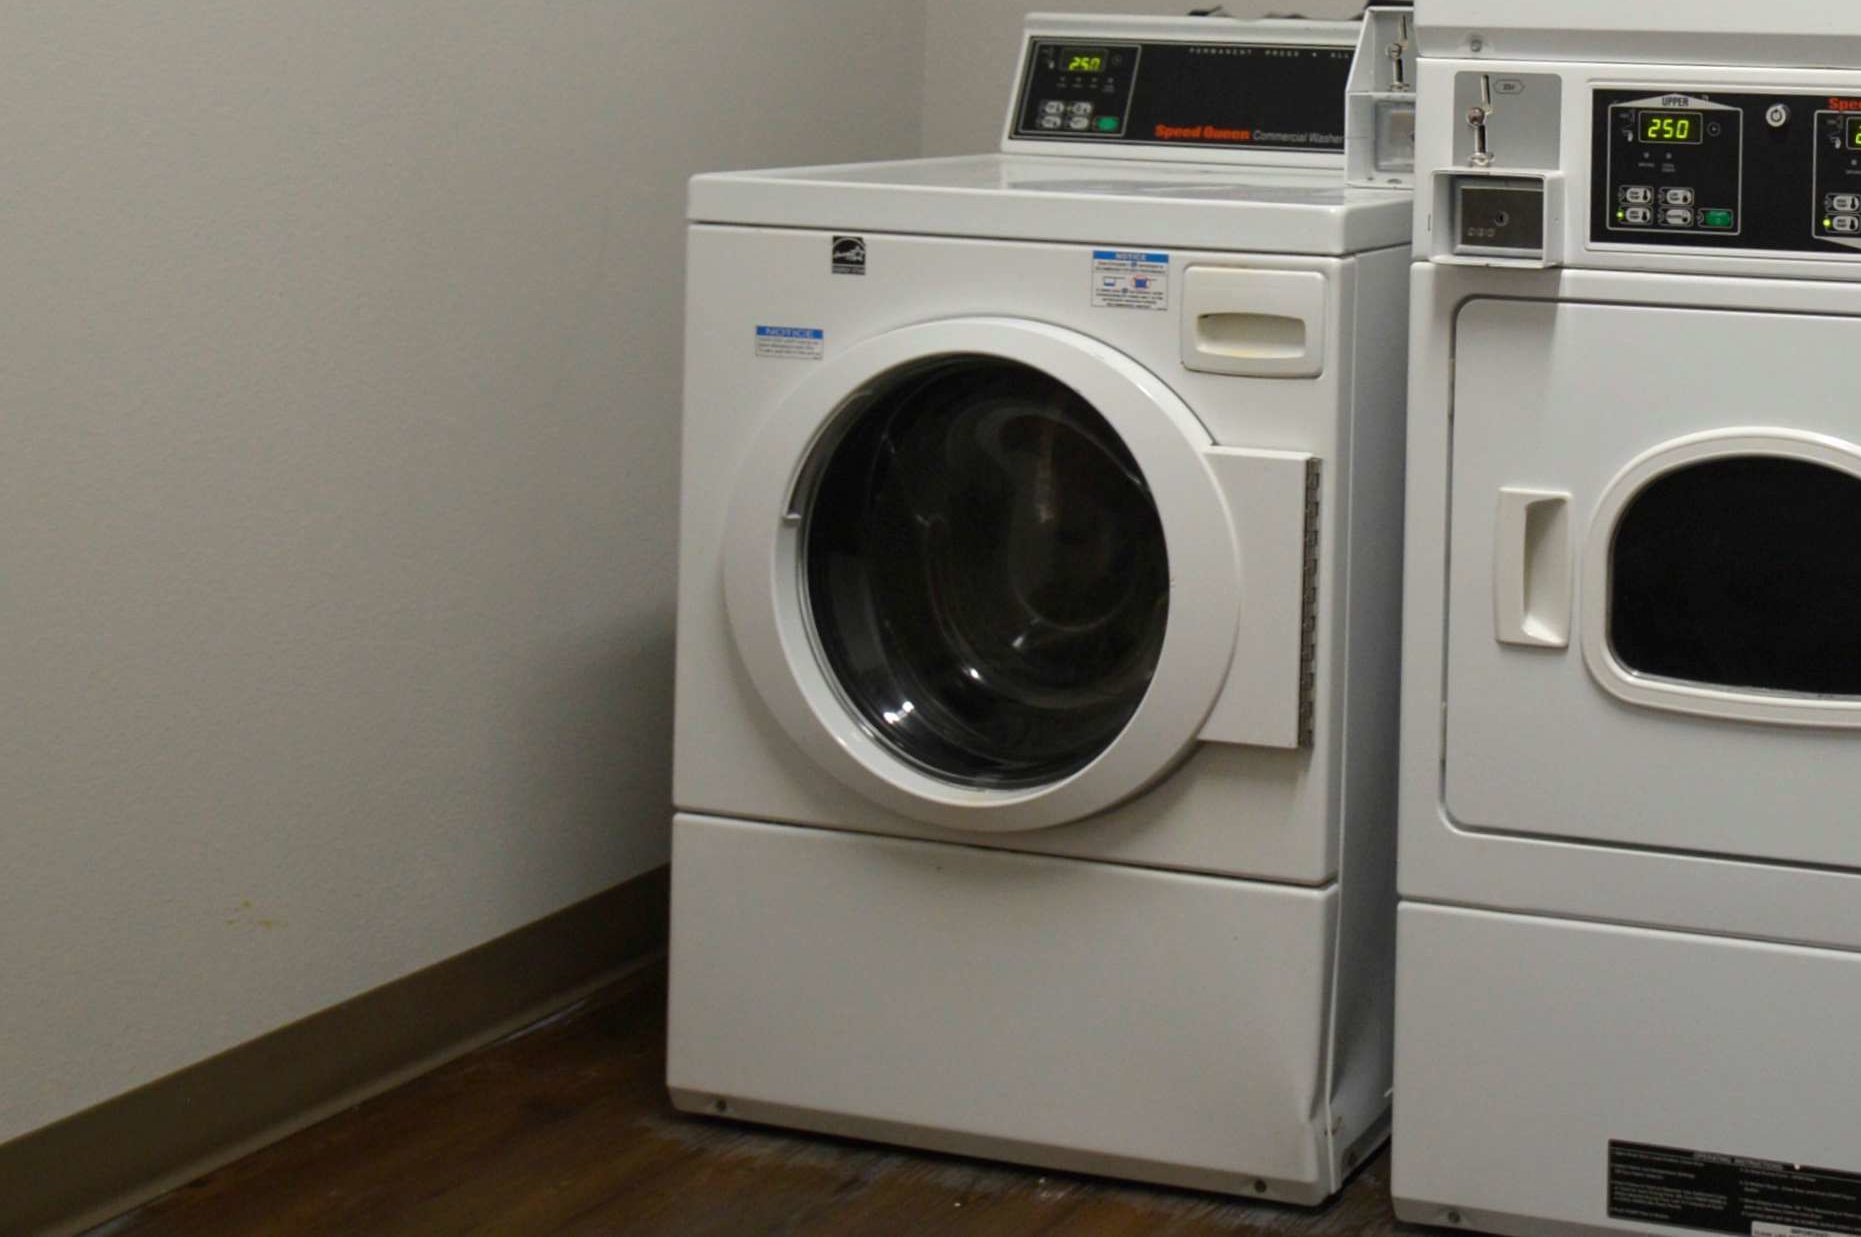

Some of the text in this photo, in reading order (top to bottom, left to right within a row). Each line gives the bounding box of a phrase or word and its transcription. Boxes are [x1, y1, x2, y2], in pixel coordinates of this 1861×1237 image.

[1661, 96, 1689, 107] UPPER
[1154, 123, 1201, 140] Speed
[1203, 125, 1251, 141] Queen
[1647, 118, 1689, 139] 250
